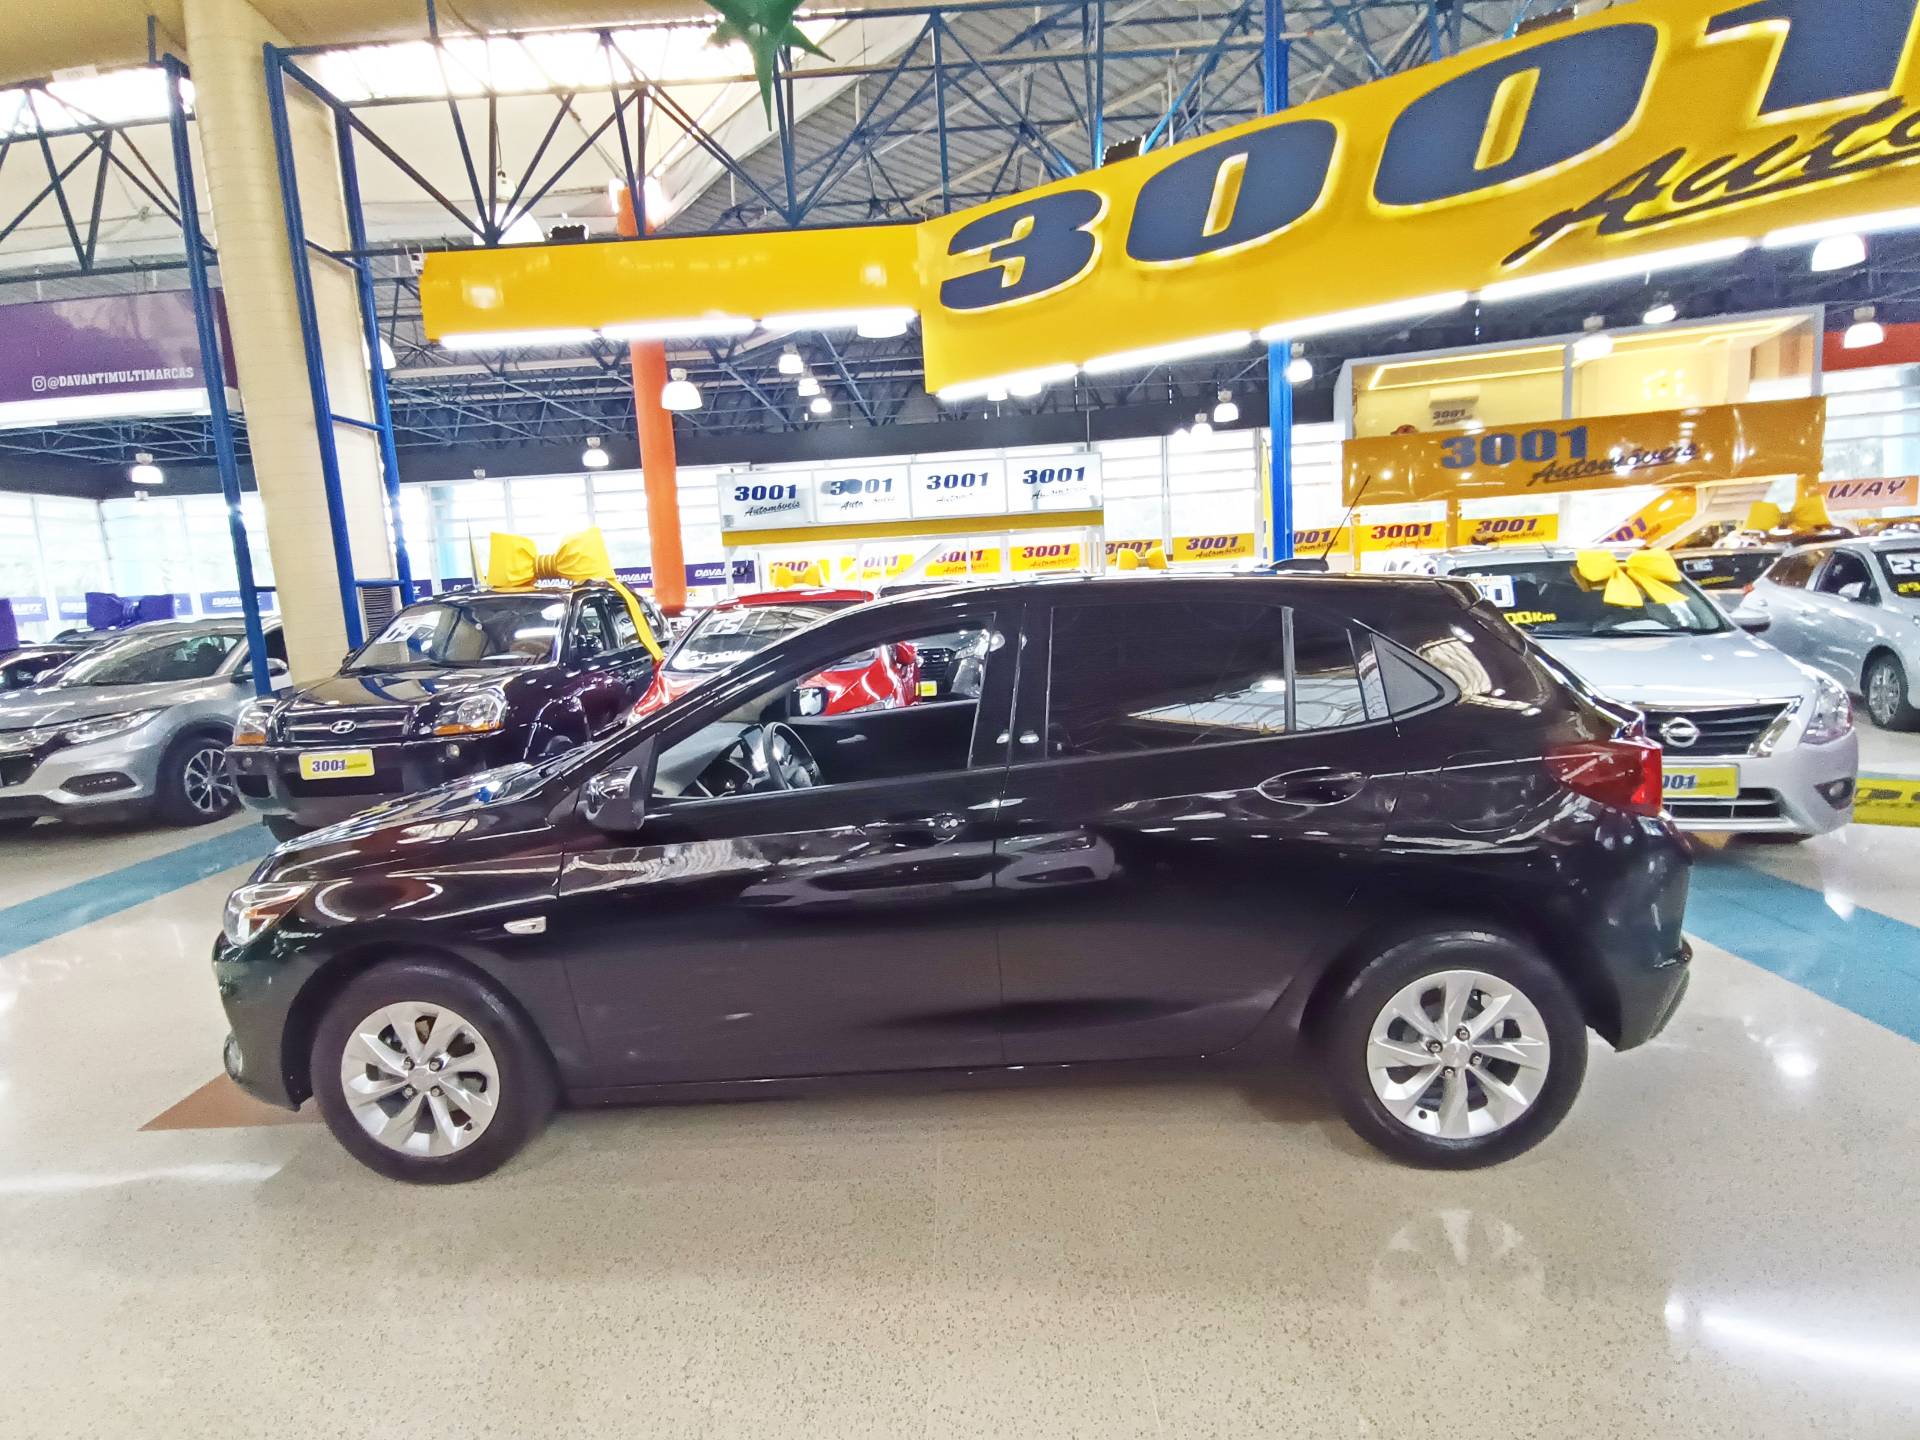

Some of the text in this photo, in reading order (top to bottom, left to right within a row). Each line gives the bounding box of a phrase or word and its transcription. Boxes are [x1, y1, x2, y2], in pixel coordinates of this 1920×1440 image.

[939, 0, 1918, 310] 3001
[47, 367, 194, 389] @DAVANTIMULTIMARCAS
[1440, 425, 1588, 470] 3001
[926, 472, 988, 490] 3001
[1023, 467, 1085, 485] 3001
[734, 484, 797, 501] 3001
[1828, 480, 1906, 499] WAY
[1371, 523, 1432, 539] 3001
[1476, 518, 1537, 534] 3001
[1186, 536, 1238, 550] 3001
[1294, 530, 1330, 544] 001
[1022, 544, 1071, 558] 3001
[312, 759, 346, 772] 3001
